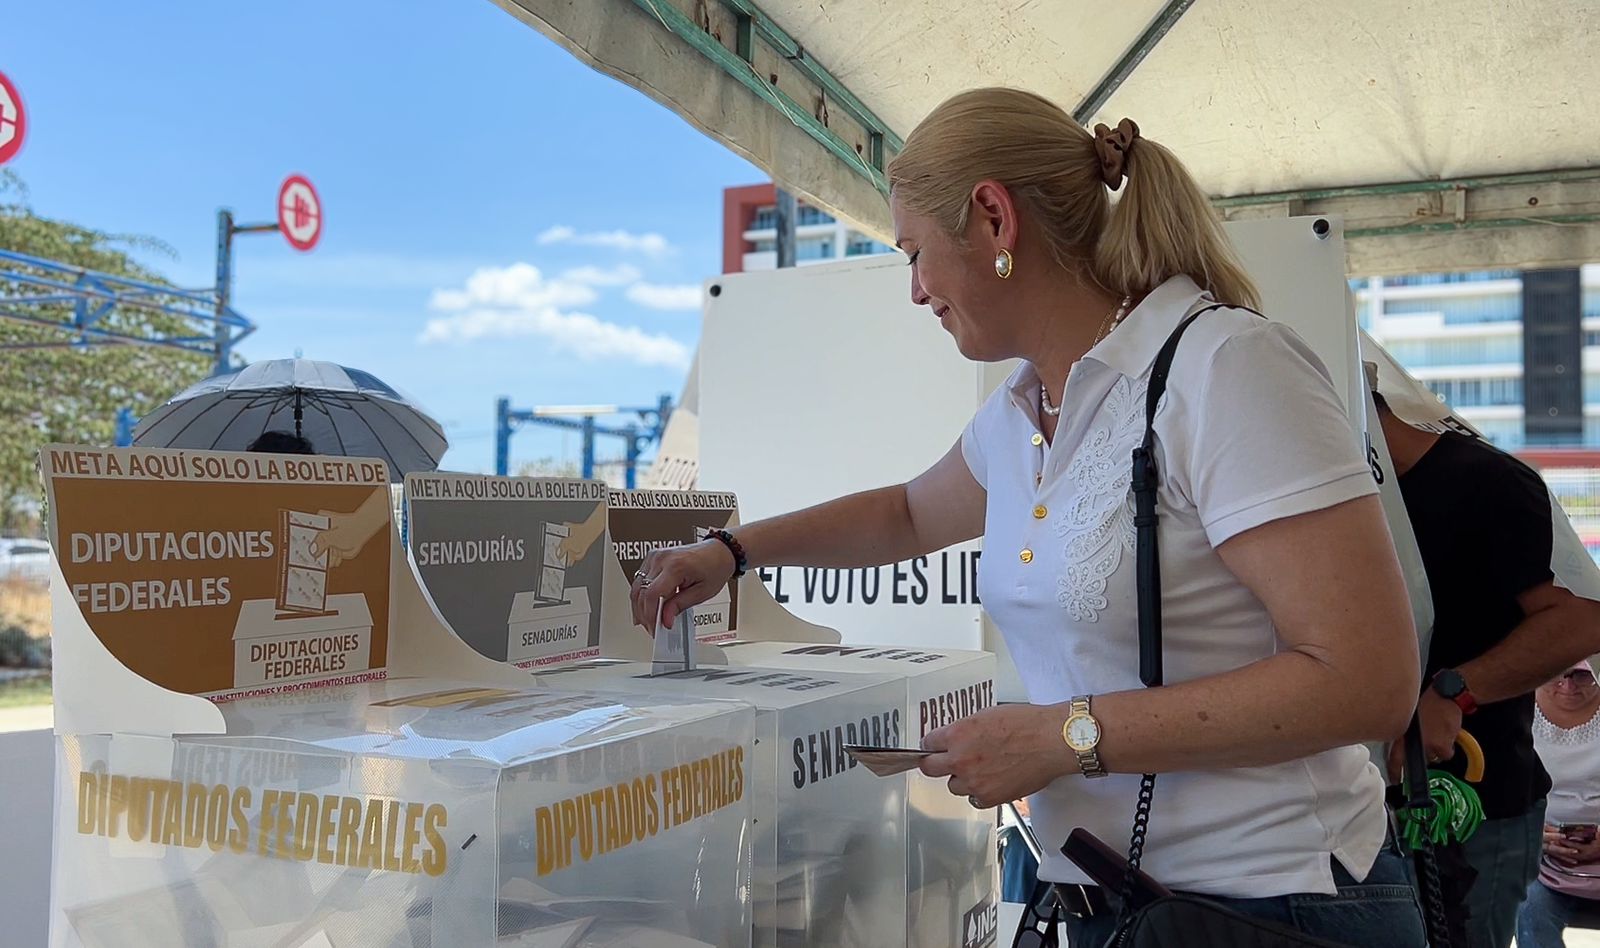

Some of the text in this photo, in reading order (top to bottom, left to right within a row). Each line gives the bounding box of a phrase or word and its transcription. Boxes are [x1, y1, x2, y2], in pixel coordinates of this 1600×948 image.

[51, 451, 386, 483] META AQUÍ SOLO LA BOLETA DE
[411, 477, 605, 499] META AQUÍ SOLO LA BOLETA DE
[631, 490, 654, 508] AQUÍ
[655, 493, 679, 507] SOLO
[680, 495, 692, 507] LA
[694, 494, 725, 508] BOLETA
[726, 495, 736, 508] DE
[71, 530, 275, 563] DIPUTACIONES
[419, 535, 525, 566] SENADURÍAS
[72, 577, 231, 613] FEDERALES
[803, 567, 880, 604] VOTO
[893, 556, 928, 604] ES
[250, 633, 359, 662] DIPUTACIONES
[522, 624, 577, 646] SENADURÍAS
[264, 653, 346, 680] FEDERALES
[345, 671, 387, 685] ELECTORALES
[920, 679, 993, 739] PRESIDENTE
[793, 708, 900, 789] SENADORES
[77, 770, 448, 877] DIPUTADOS FEDERALES
[535, 773, 659, 877] DIPUTADOS
[660, 745, 743, 830] FEDERALES
[977, 903, 997, 943] INE
